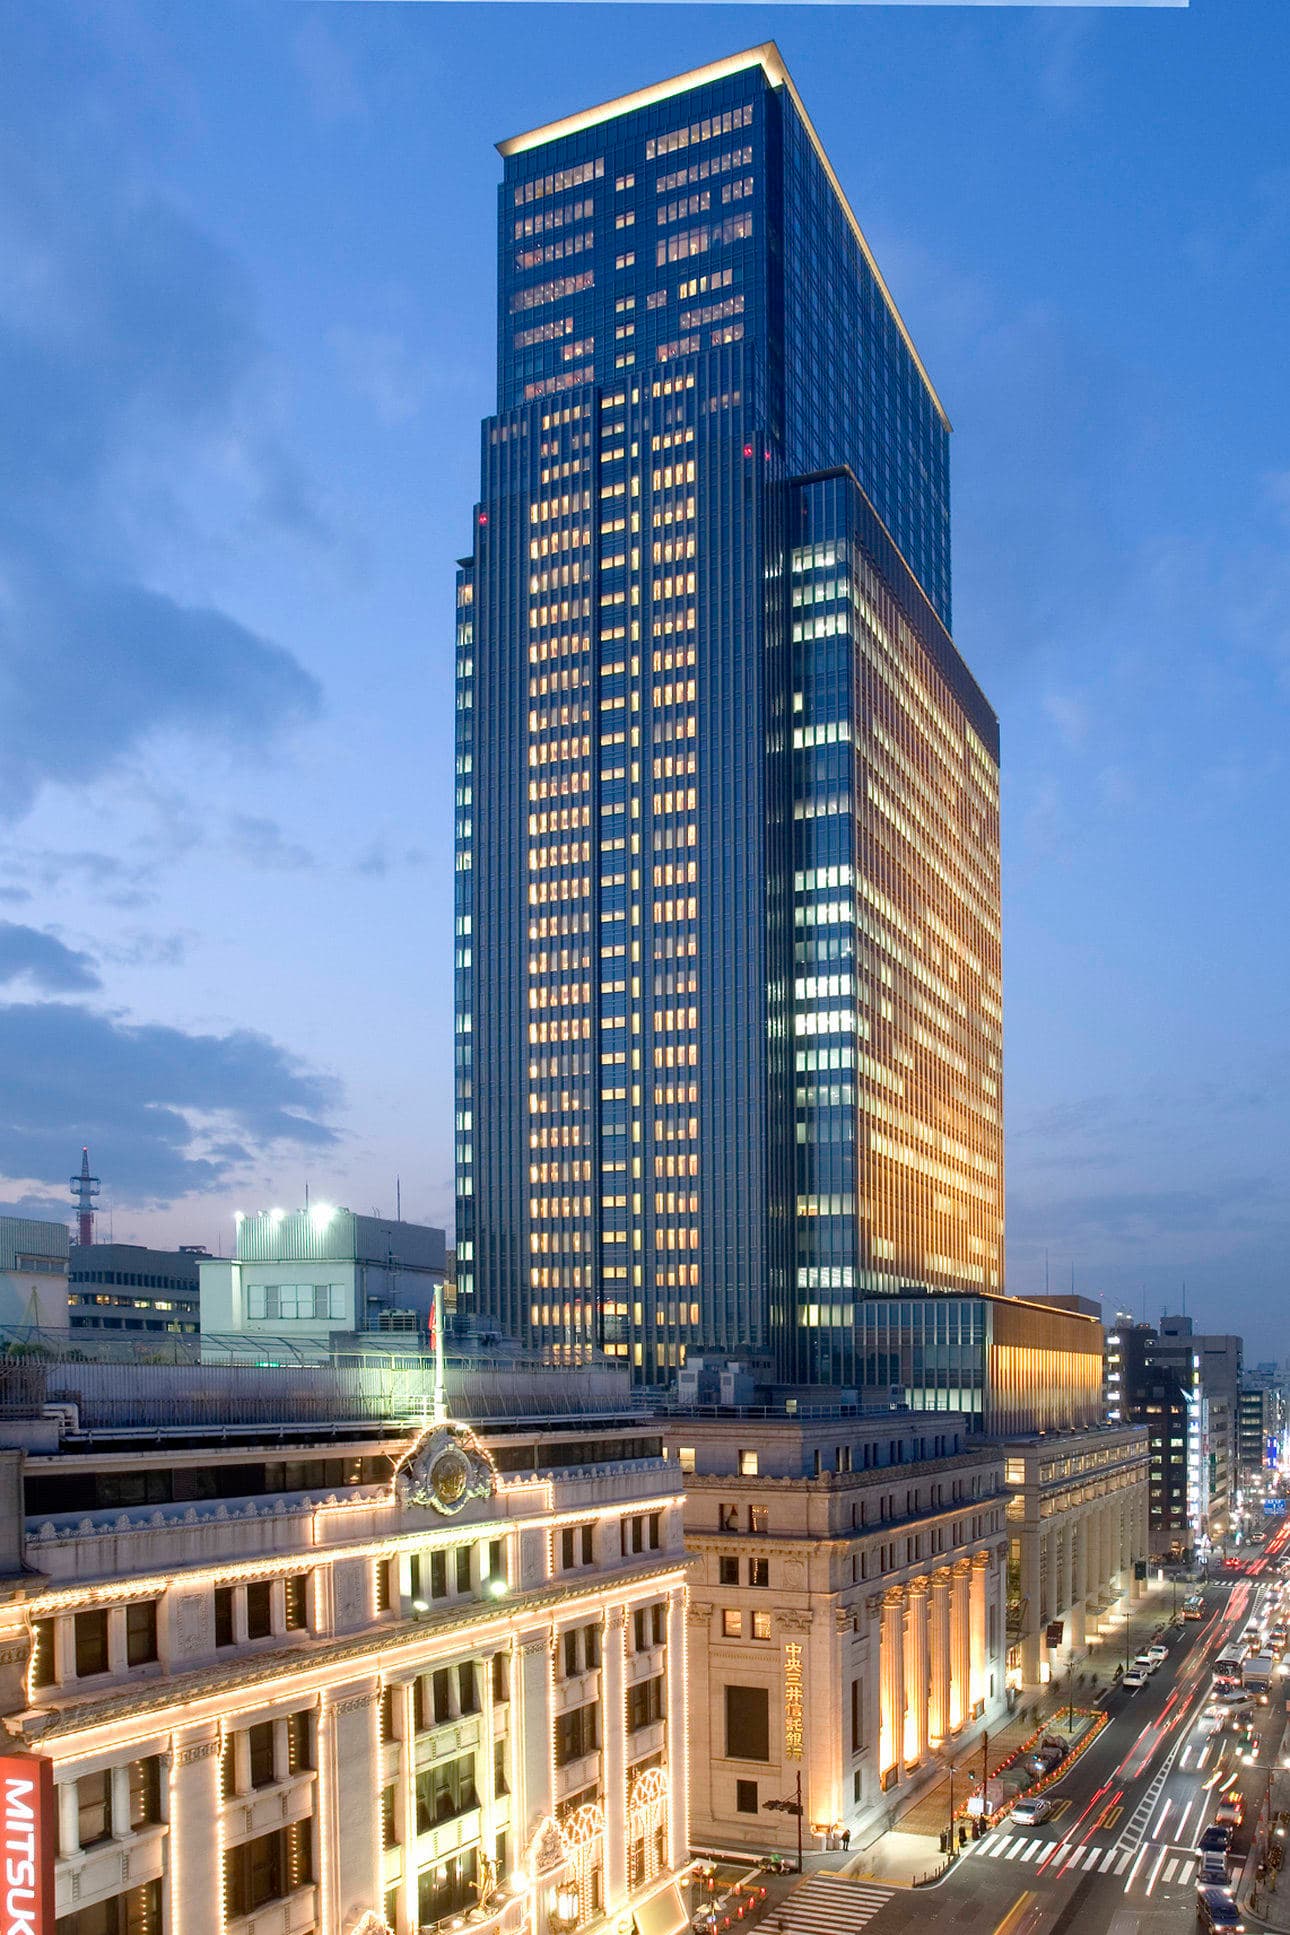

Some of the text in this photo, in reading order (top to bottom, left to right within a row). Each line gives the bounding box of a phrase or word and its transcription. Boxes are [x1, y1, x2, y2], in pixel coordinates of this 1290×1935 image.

[784, 1642, 804, 1761] 中央三井信託銀行
